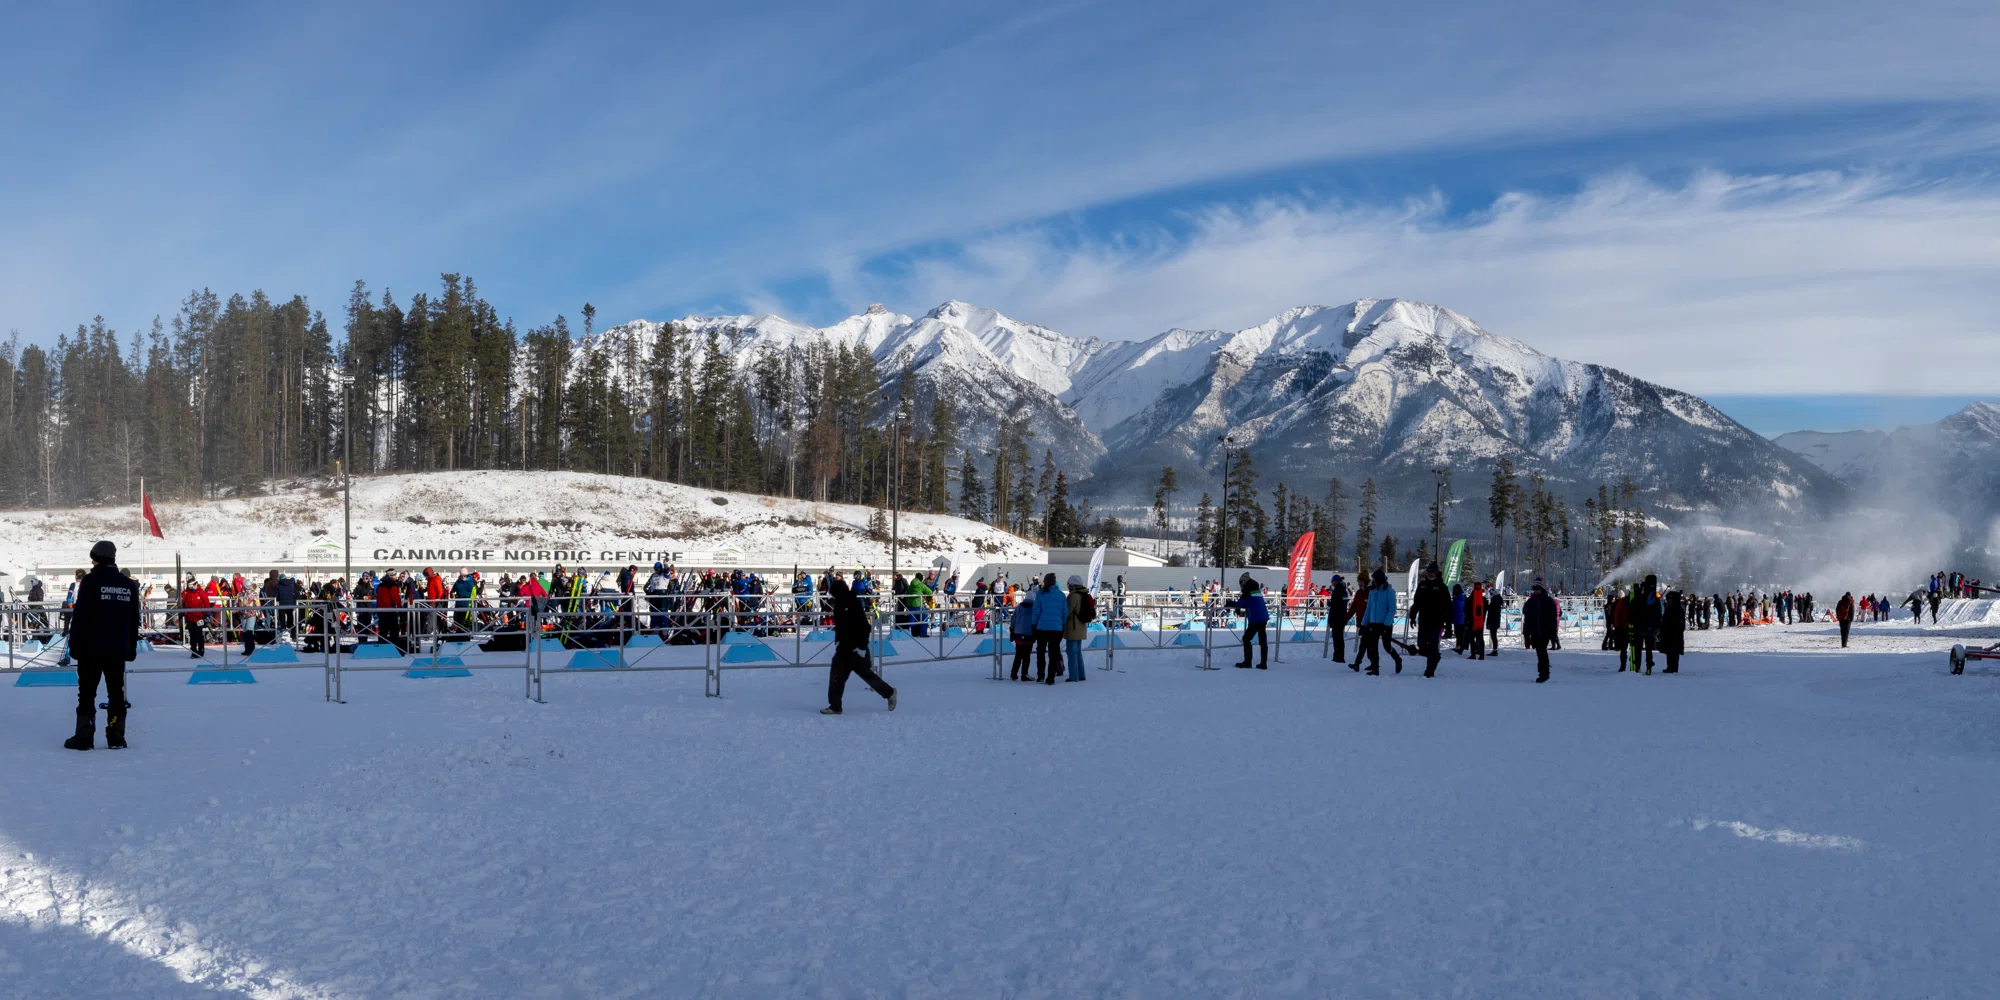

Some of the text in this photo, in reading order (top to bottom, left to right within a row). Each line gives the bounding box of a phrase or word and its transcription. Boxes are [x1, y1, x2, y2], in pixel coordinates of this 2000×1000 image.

[373, 548, 684, 561] CANMORE NORDIC CENTRE
[100, 586, 132, 596] OMINECA
[116, 594, 131, 602] CLUB
